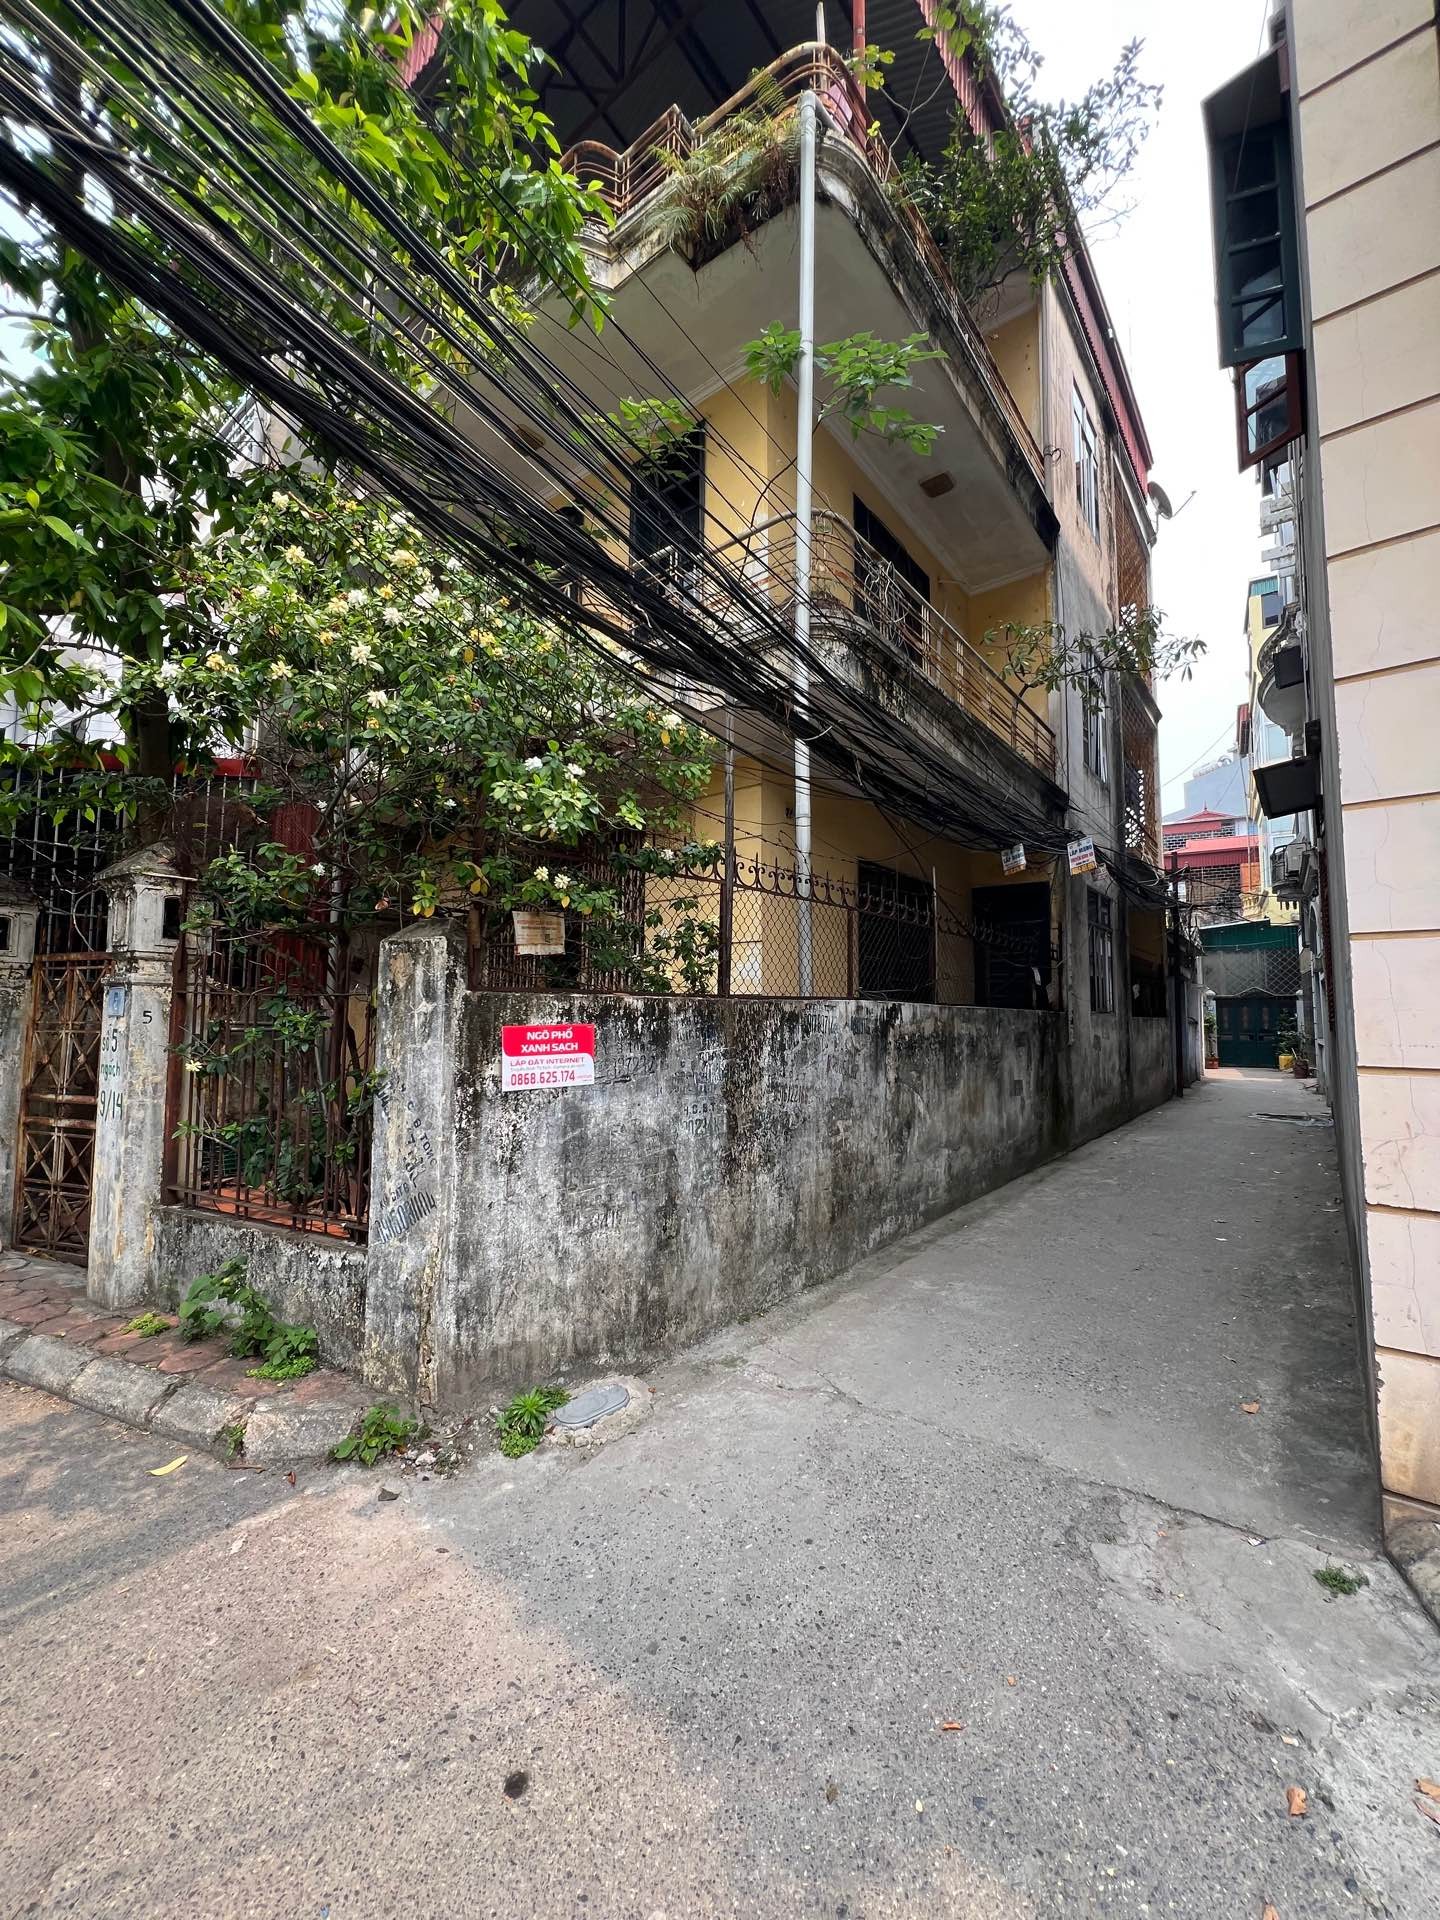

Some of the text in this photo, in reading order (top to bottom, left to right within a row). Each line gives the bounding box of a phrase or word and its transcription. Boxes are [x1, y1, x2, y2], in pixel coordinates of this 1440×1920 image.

[142, 1010, 153, 1024] 5
[111, 1029, 118, 1052] 5
[551, 1027, 573, 1040] PHỐ
[521, 1042, 579, 1053] XANH SẠCH
[546, 1056, 585, 1065] INTERNET
[510, 1070, 576, 1086] 0868.625.174
[99, 1089, 123, 1122] 9/14
